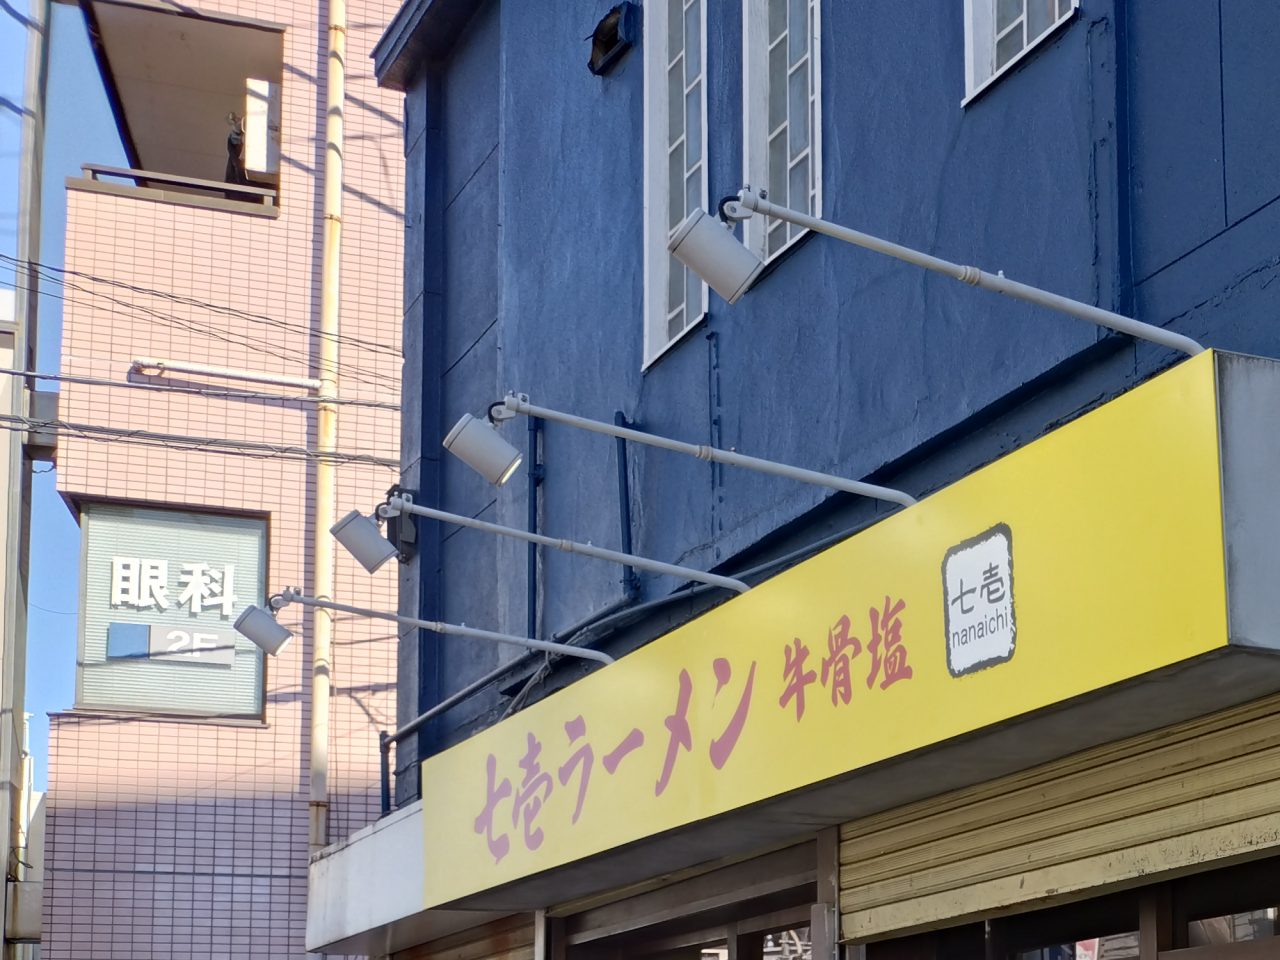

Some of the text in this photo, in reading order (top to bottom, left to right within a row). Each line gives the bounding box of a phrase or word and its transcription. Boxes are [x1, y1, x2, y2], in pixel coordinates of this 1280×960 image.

[110, 556, 239, 617] 眼科
[951, 562, 1006, 615] 七壱
[166, 630, 219, 658] 2F
[952, 606, 1009, 648] nanaichi
[474, 595, 913, 866] 七壱ラーメン 牛骨塩
